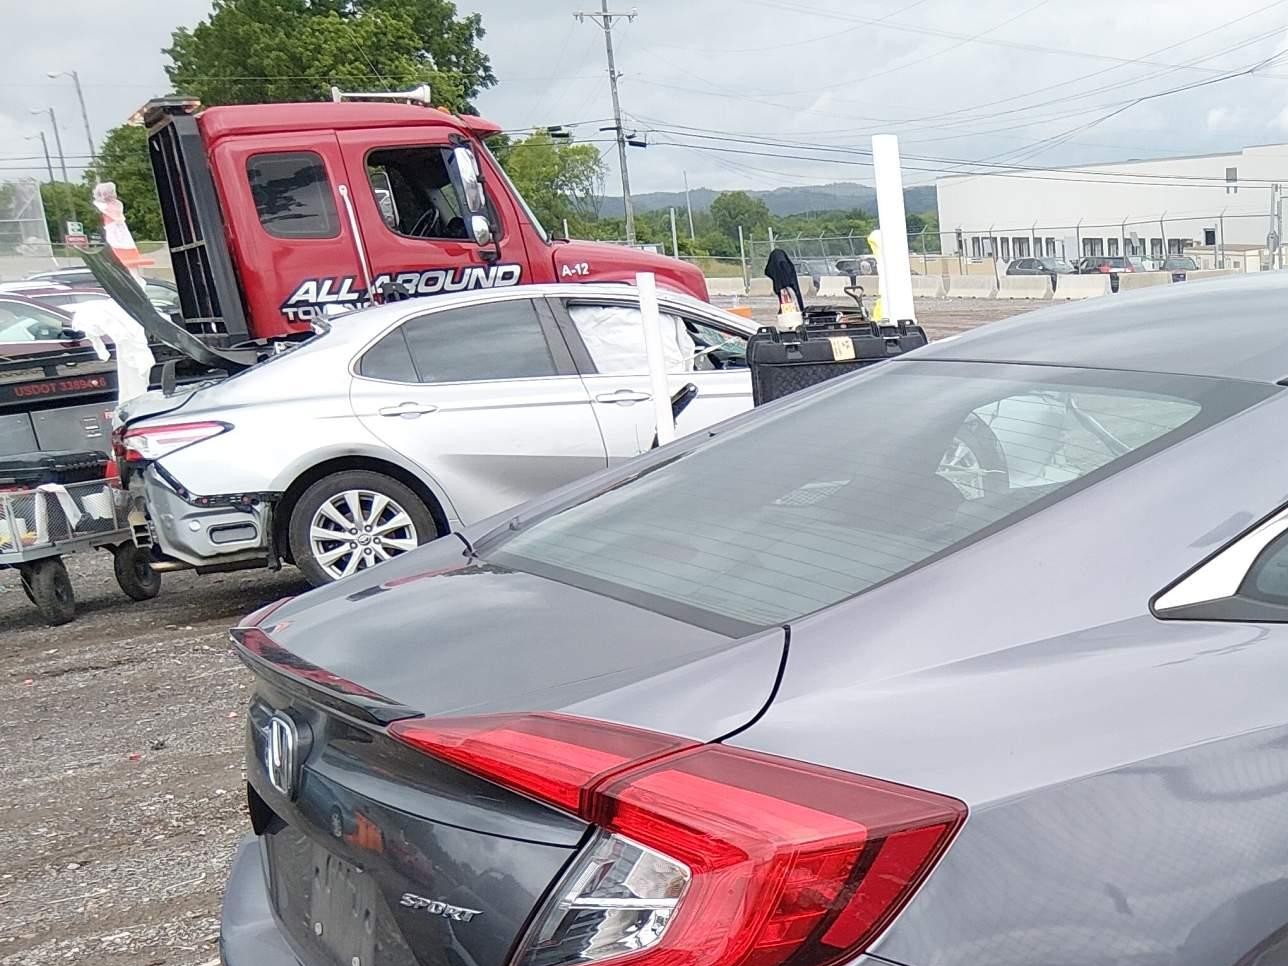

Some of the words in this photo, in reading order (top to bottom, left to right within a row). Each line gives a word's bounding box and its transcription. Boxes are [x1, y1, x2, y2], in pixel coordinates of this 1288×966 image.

[562, 262, 590, 277] A-12
[286, 278, 360, 304] ALL
[15, 383, 56, 396] USDOT
[400, 893, 483, 922] SPORT
